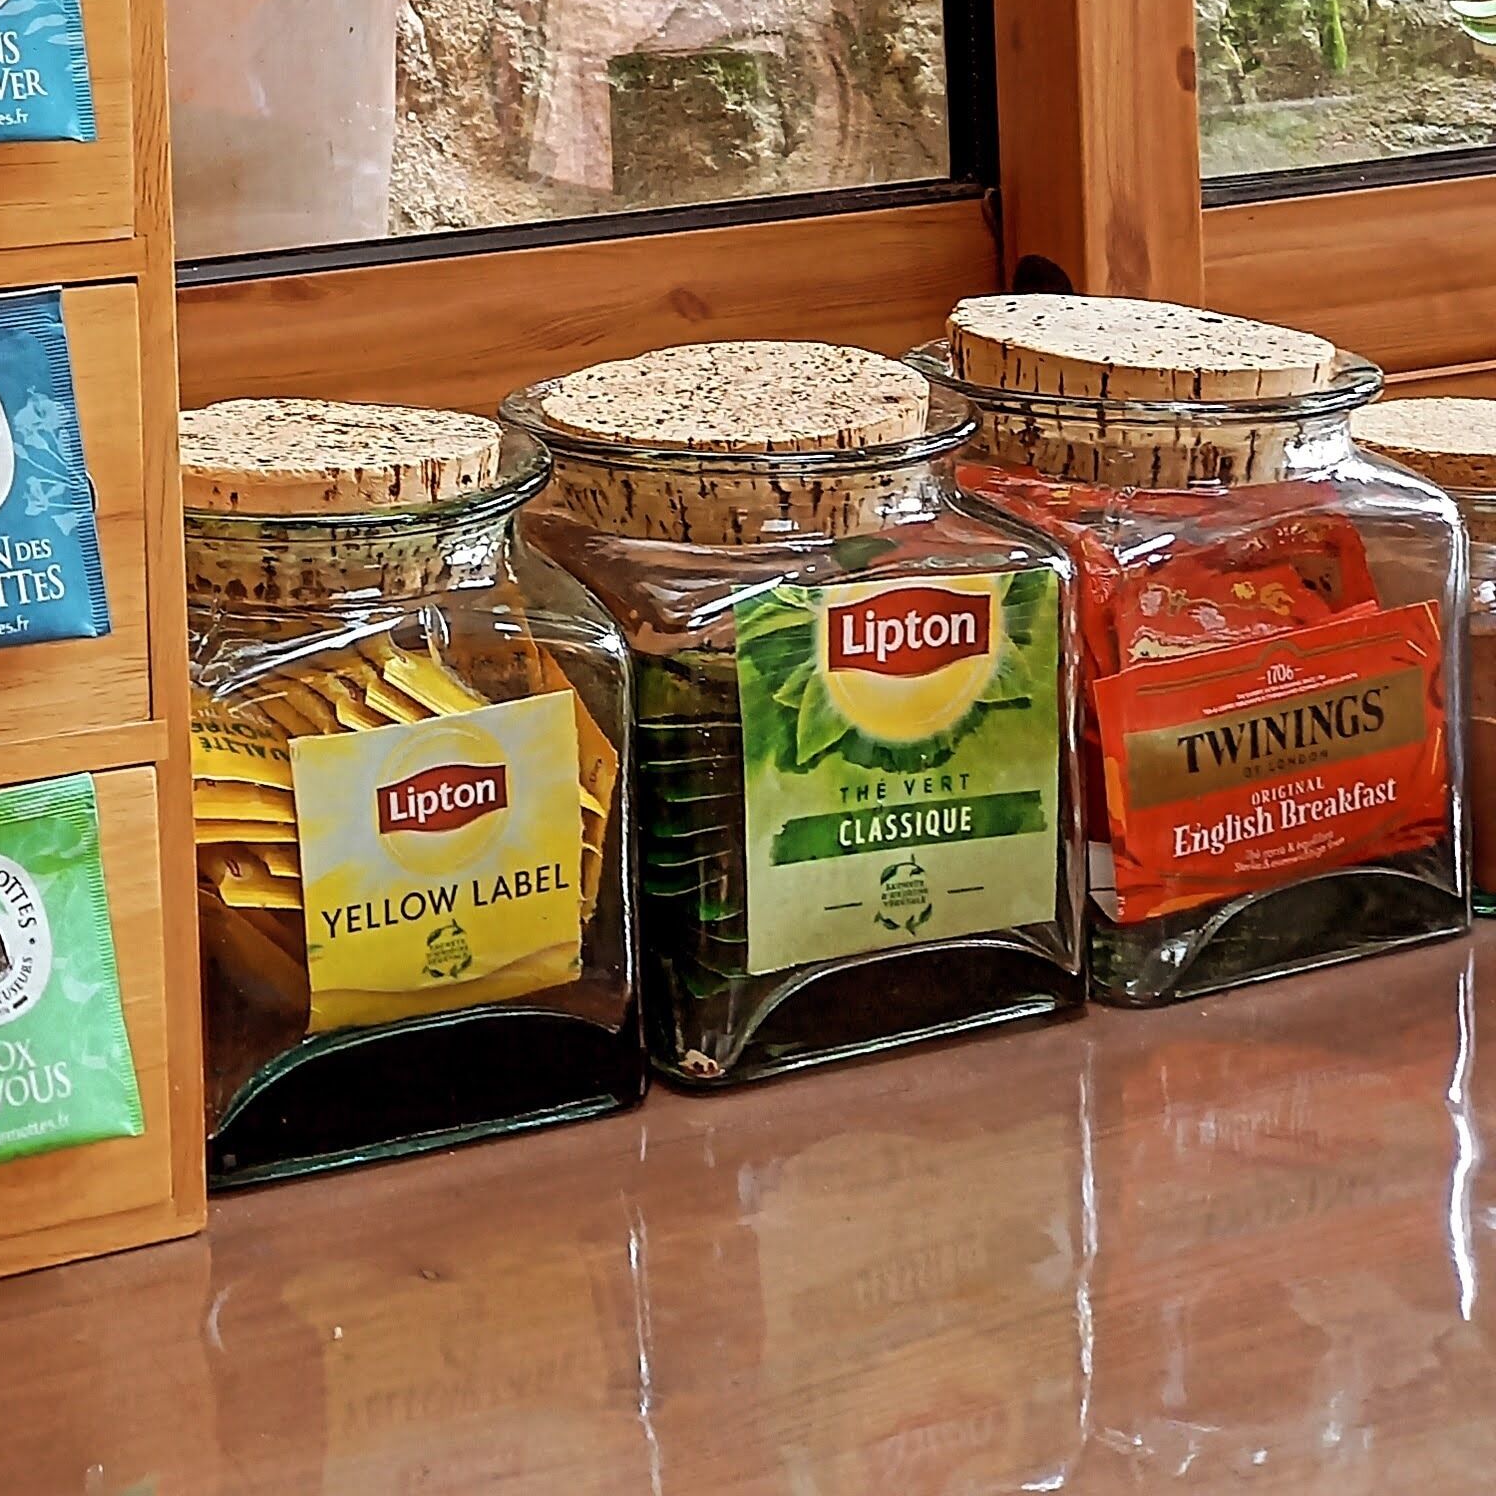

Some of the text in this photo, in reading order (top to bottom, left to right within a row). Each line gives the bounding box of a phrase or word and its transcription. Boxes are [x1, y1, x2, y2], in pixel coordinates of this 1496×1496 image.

[15, 539, 52, 562] DES
[842, 610, 976, 662] Lipton
[199, 736, 290, 762] UALITÉ
[1178, 688, 1384, 773] TWININGS
[389, 778, 496, 824] Lipton
[840, 773, 969, 803] THÉ VERT
[1252, 777, 1325, 805] ORIGINAL
[839, 806, 972, 846] CLASSIQUE
[1173, 806, 1274, 857] English
[1280, 777, 1397, 829] Breakfast
[322, 864, 569, 938] YELLOW LABEL
